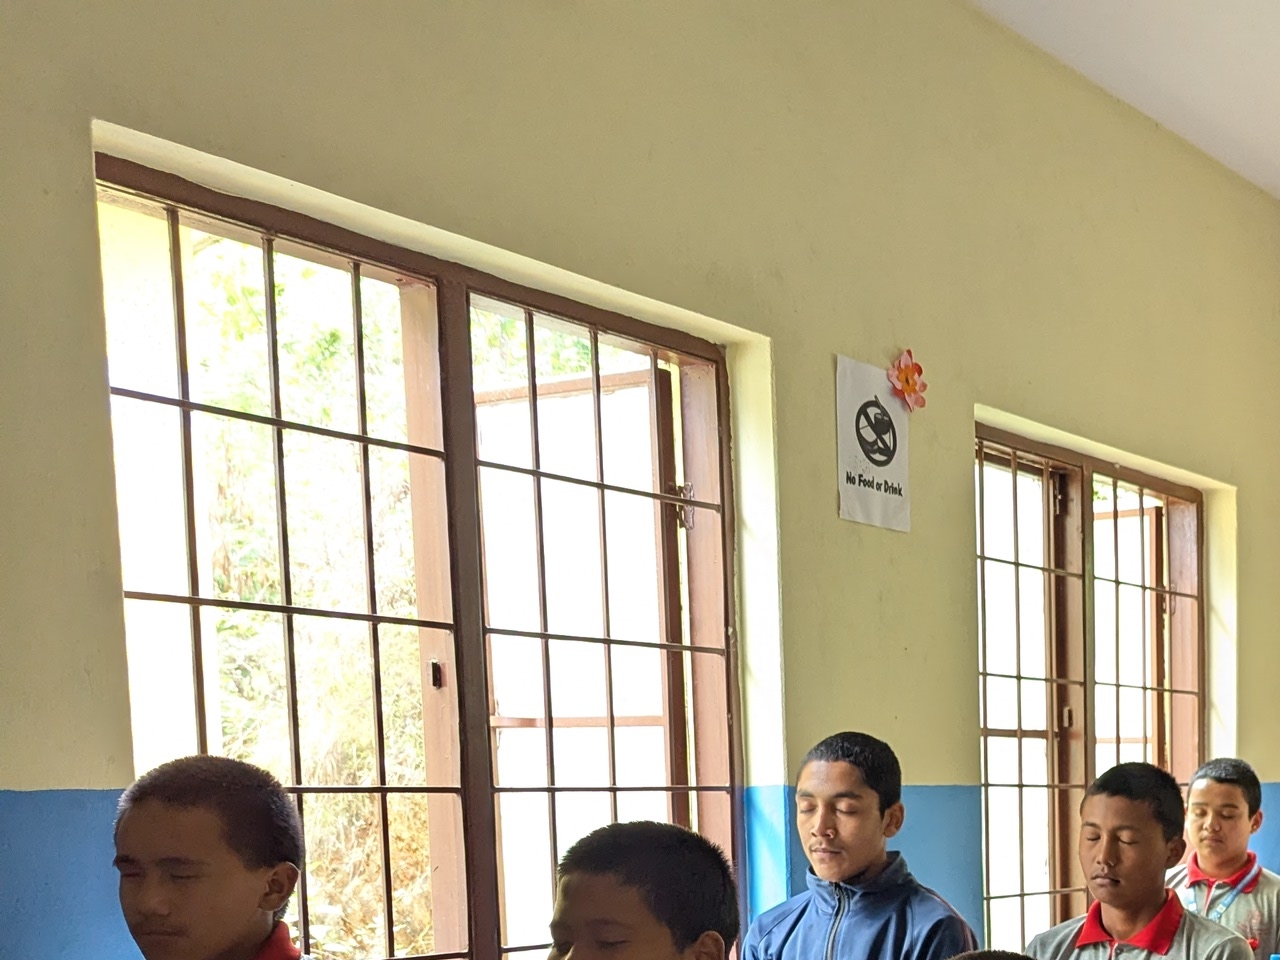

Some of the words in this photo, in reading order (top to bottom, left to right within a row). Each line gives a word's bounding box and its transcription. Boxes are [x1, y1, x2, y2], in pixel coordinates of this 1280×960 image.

[846, 471, 856, 486] No
[858, 473, 875, 490] Food
[876, 481, 883, 492] or
[884, 480, 903, 497] Drink
